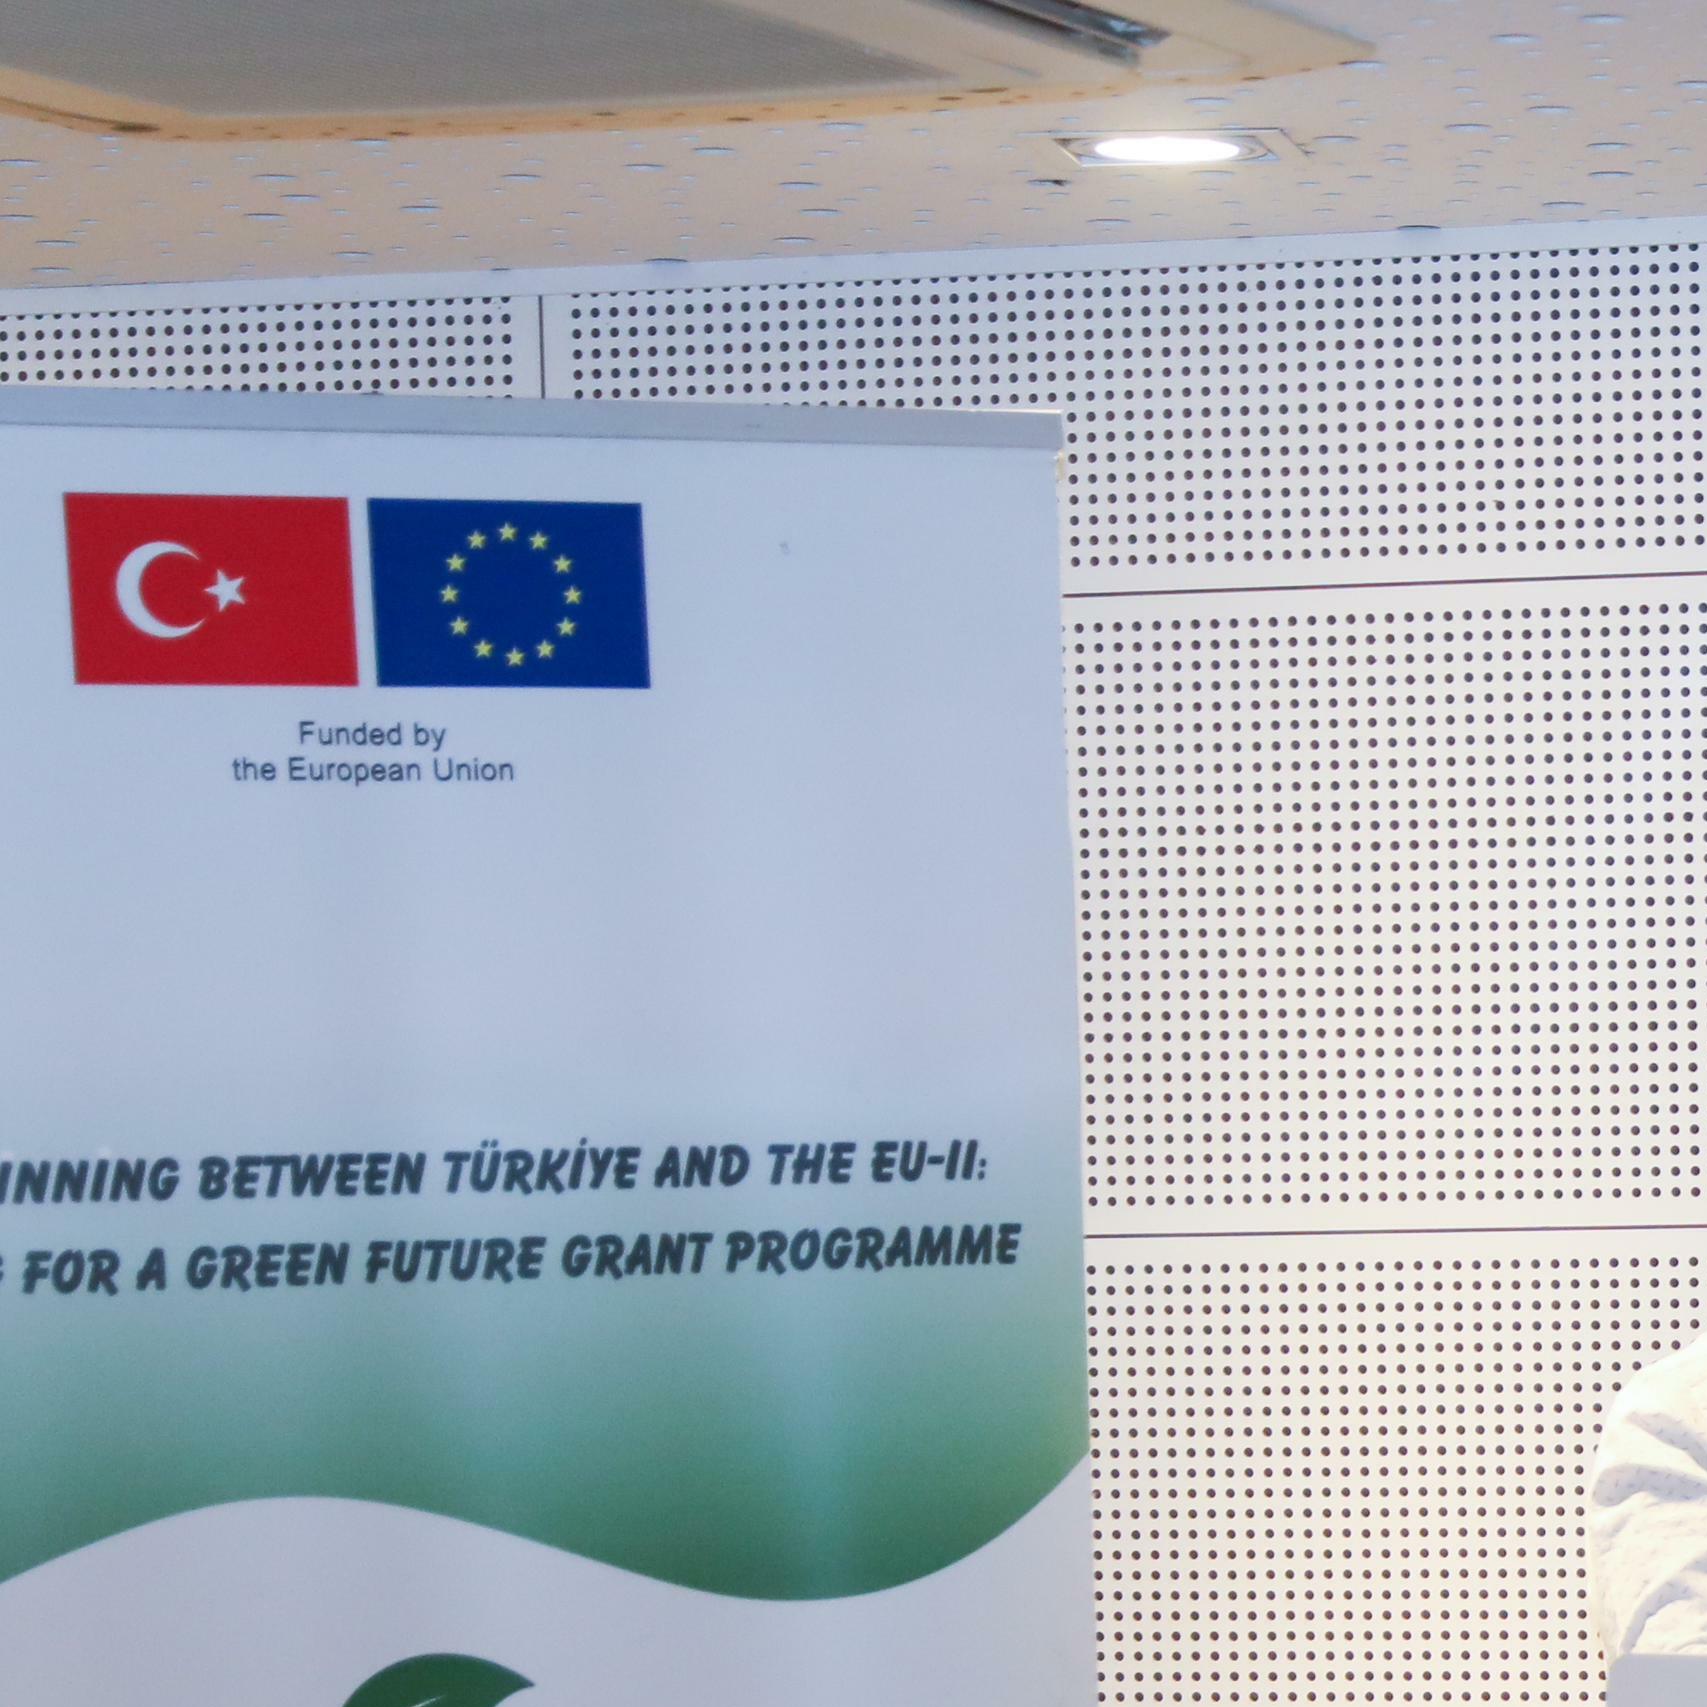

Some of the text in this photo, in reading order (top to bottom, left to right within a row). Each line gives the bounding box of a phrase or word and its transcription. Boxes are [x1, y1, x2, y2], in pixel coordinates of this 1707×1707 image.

[299, 721, 446, 752] Funded by
[232, 757, 514, 786] the European Union
[199, 1153, 426, 1200] BETWEEN
[444, 1138, 641, 1195] TÜRKİYE
[654, 1145, 750, 1188] AND
[768, 1142, 856, 1185] THE
[23, 1223, 1021, 1296] FOR A GREEN FUTURE GRANT PROGRAMME
